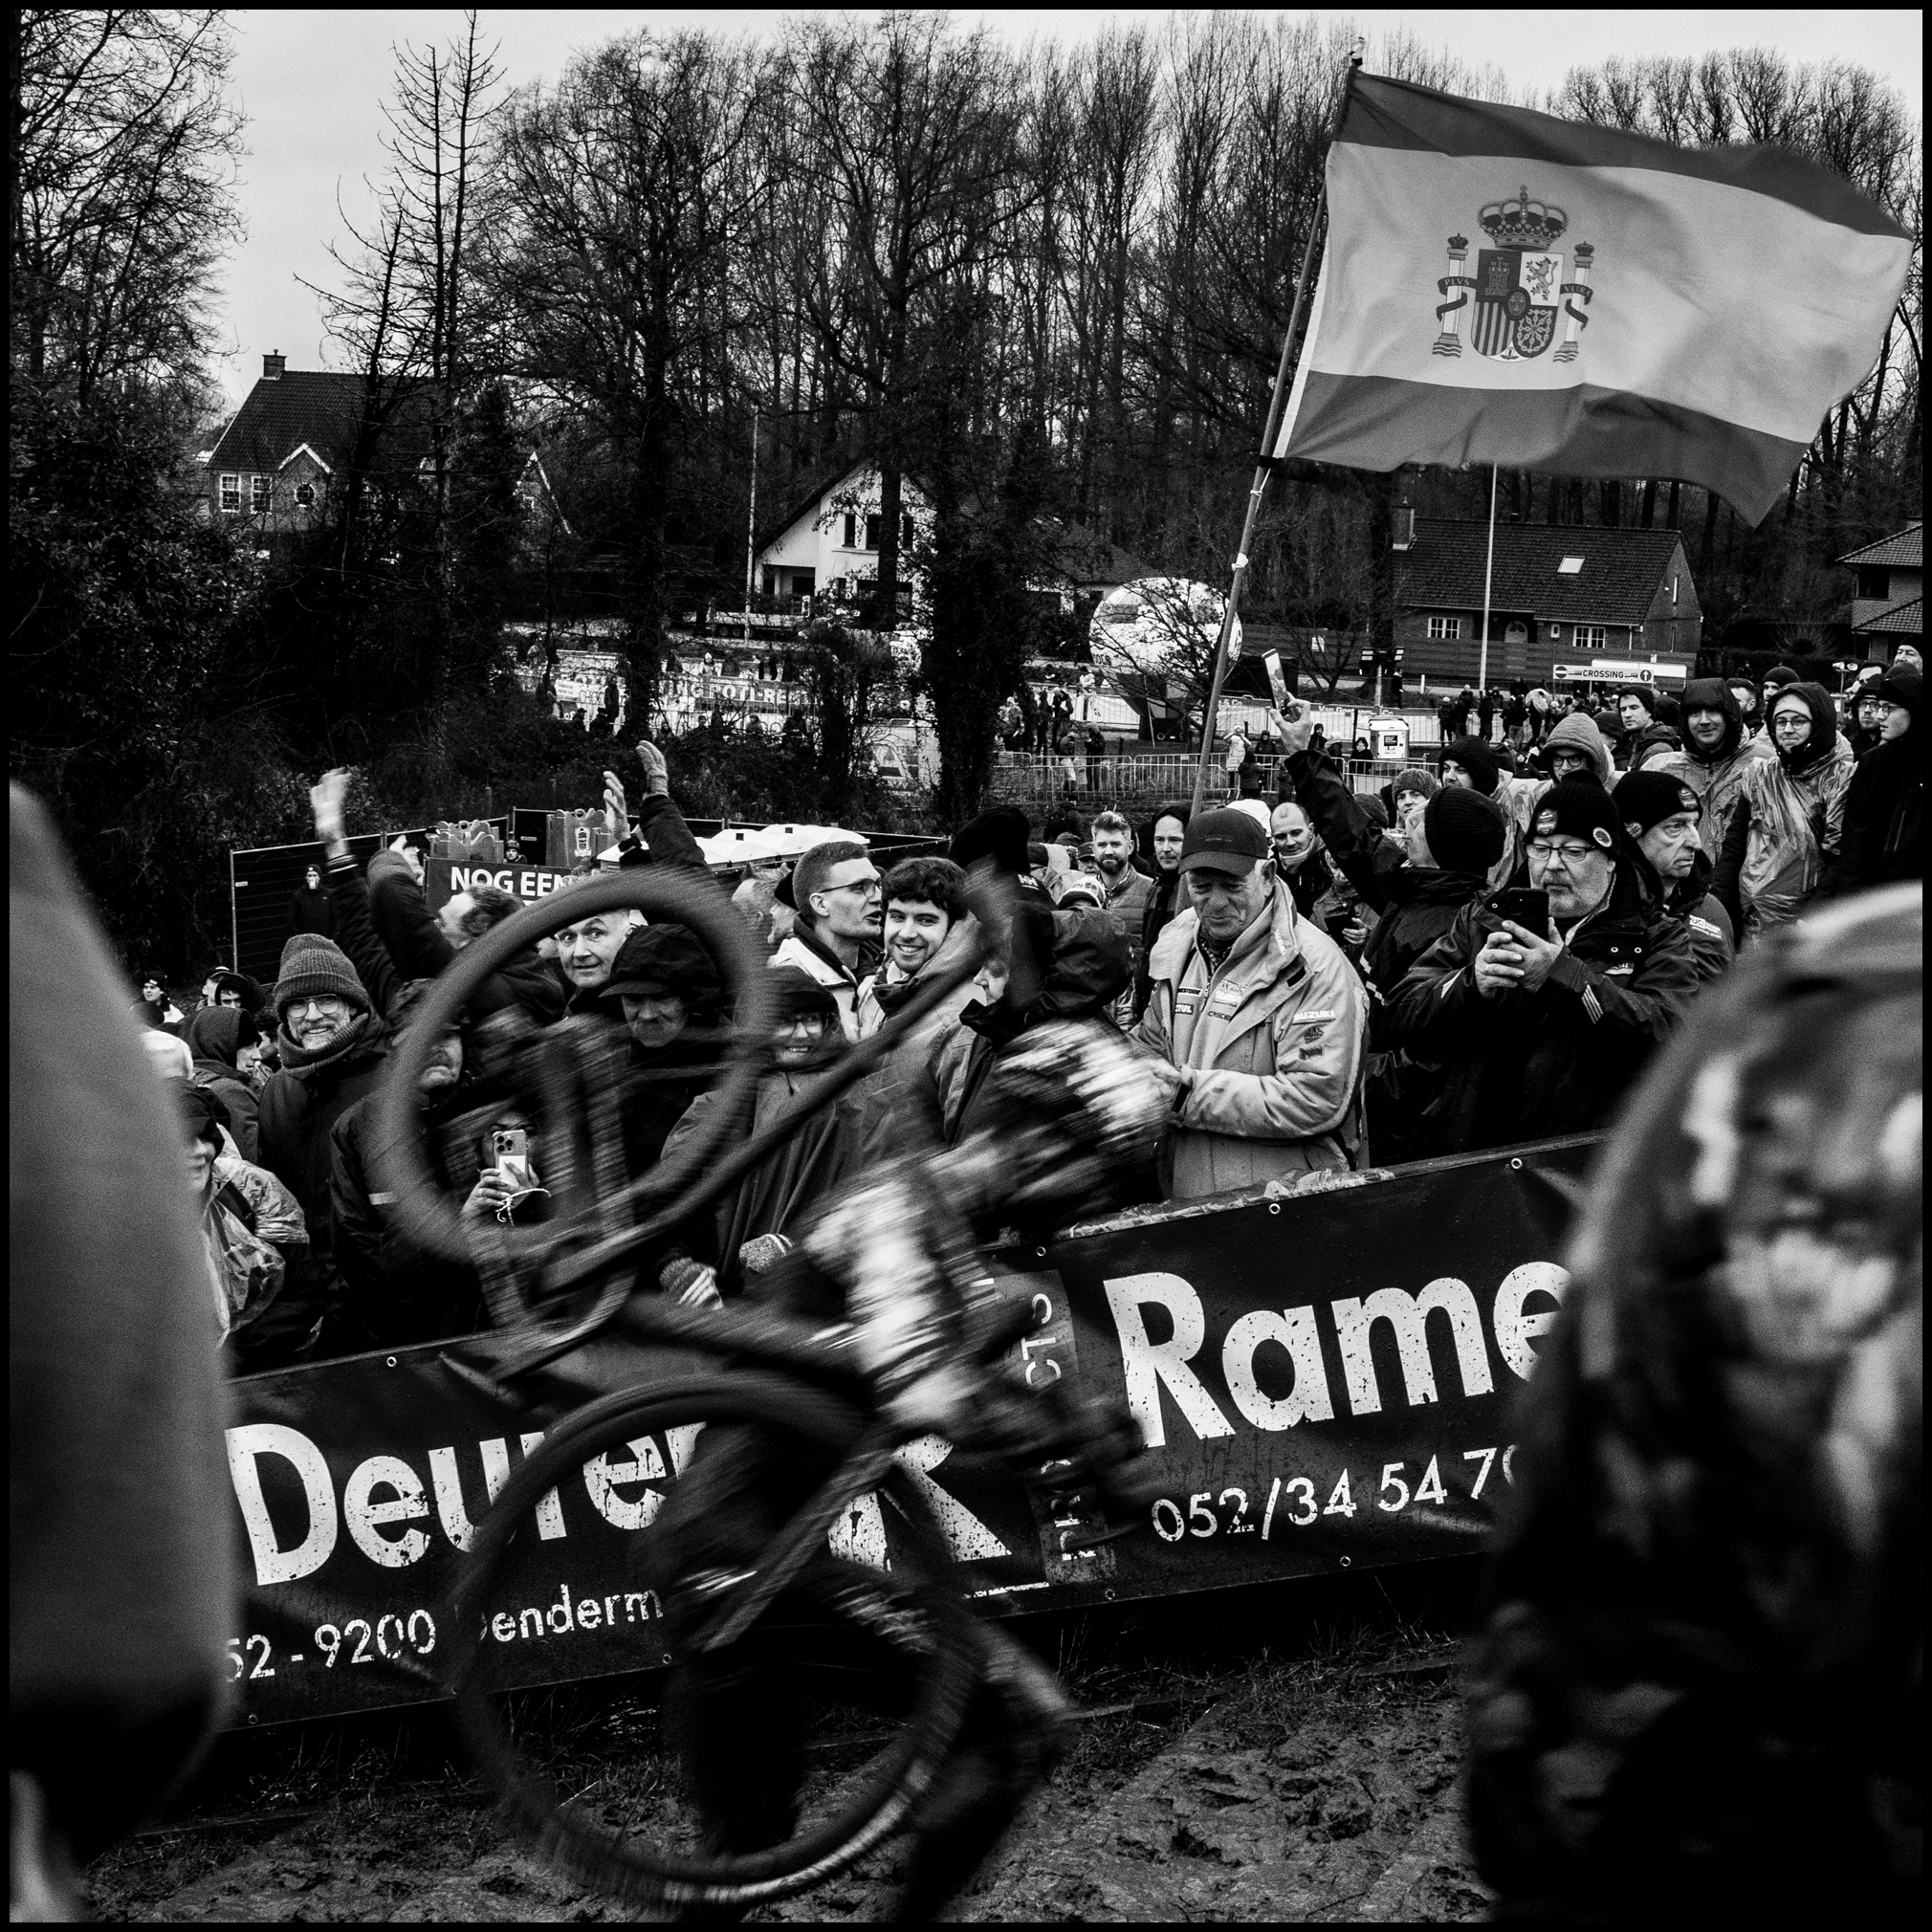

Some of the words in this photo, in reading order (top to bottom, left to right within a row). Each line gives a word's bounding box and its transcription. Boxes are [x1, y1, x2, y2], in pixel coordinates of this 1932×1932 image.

[1444, 277, 1470, 286] PLVS
[1583, 670, 1624, 679] CROSSING
[451, 866, 514, 893] NOG
[1103, 1262, 1572, 1448] Rame
[1151, 1468, 1356, 1543] 052/34
[1377, 1454, 1448, 1513] 54
[314, 1609, 437, 1669] 9200
